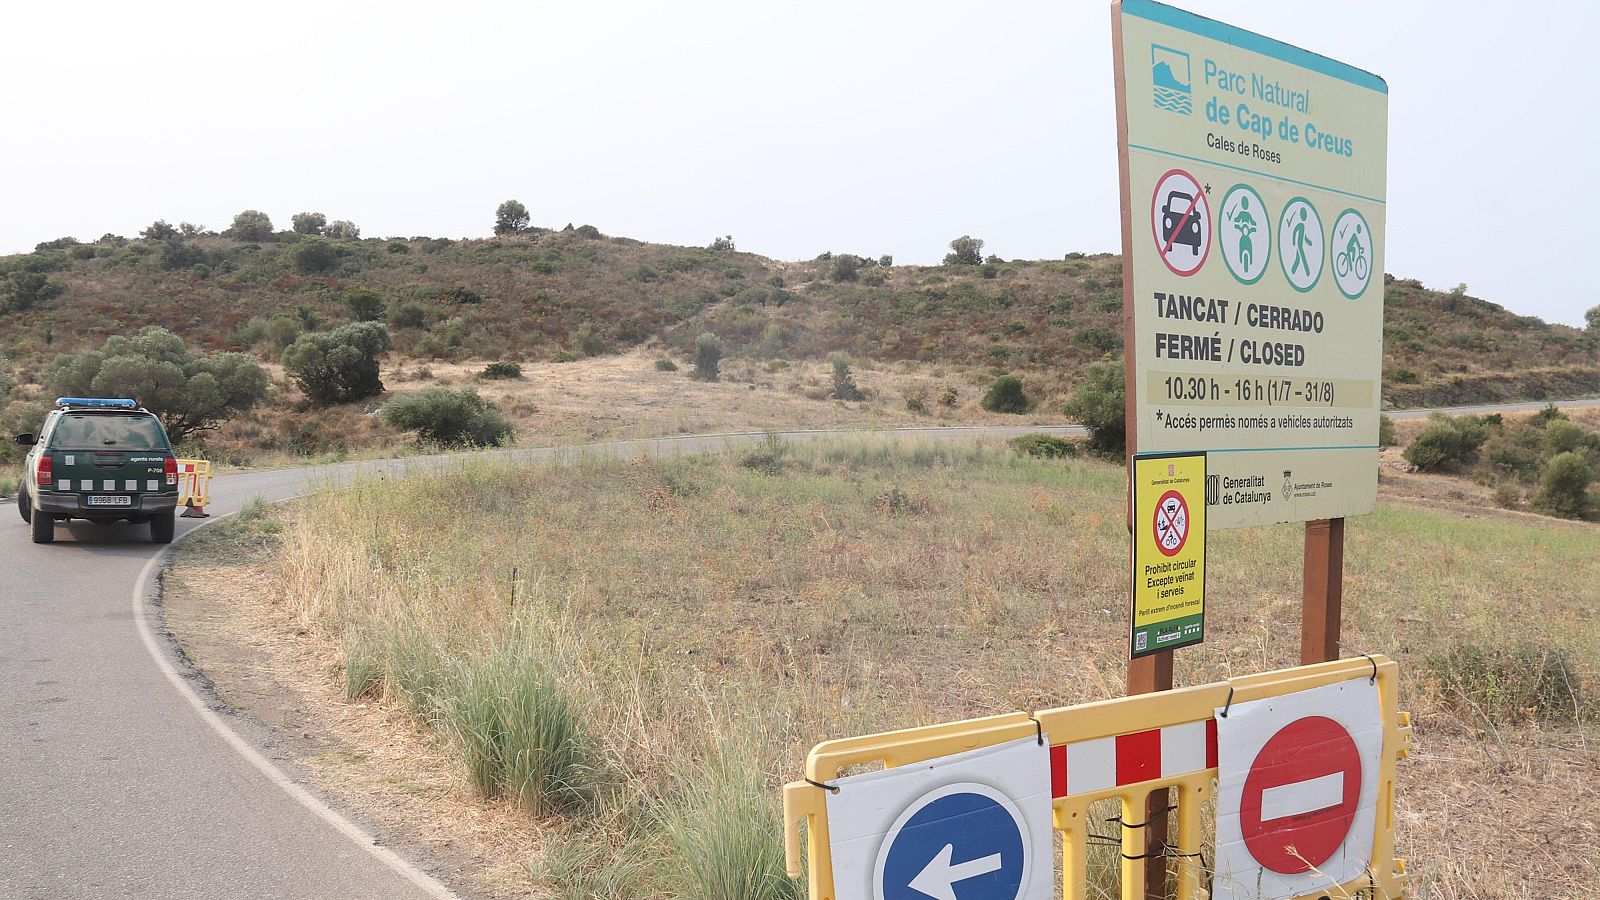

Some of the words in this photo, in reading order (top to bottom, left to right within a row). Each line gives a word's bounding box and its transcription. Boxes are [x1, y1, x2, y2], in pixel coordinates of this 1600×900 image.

[1204, 59, 1246, 95] Parc
[1252, 72, 1309, 113] Natural
[1206, 97, 1230, 125] de
[1237, 103, 1273, 140] Cap
[1278, 116, 1299, 144] de
[1304, 122, 1353, 158] Creus
[1207, 132, 1235, 153] Cales
[1238, 137, 1250, 156] de
[1252, 144, 1281, 164] Roses
[1154, 292, 1229, 324] TANCAT
[1234, 301, 1241, 326] /
[1247, 303, 1324, 333] CERRADO
[1155, 332, 1222, 362] FERMÉ
[1227, 338, 1234, 363] /
[1240, 340, 1305, 367] CLOSED
[1165, 376, 1206, 400] 10.30
[1210, 378, 1220, 401] h
[1235, 379, 1251, 401] 16
[1255, 379, 1263, 401] h
[1267, 379, 1292, 406] (1/7
[1305, 381, 1334, 407] 31/8)
[1199, 414, 1236, 432] permès
[1238, 414, 1268, 429] només
[1270, 417, 1276, 429] a
[1278, 414, 1311, 429] vehicles
[1313, 413, 1353, 429] autoritzats
[1223, 475, 1264, 489] Generalitat
[1223, 492, 1233, 505] de
[1234, 491, 1271, 505] Catalunya
[1145, 562, 1171, 576] Prohibit
[1172, 559, 1197, 571] circular
[1147, 575, 1174, 588] Excepte
[1160, 585, 1184, 599] serveis
[1138, 608, 1150, 616] Perill
[1150, 606, 1165, 614] extrem
[1184, 599, 1200, 608] forestal
